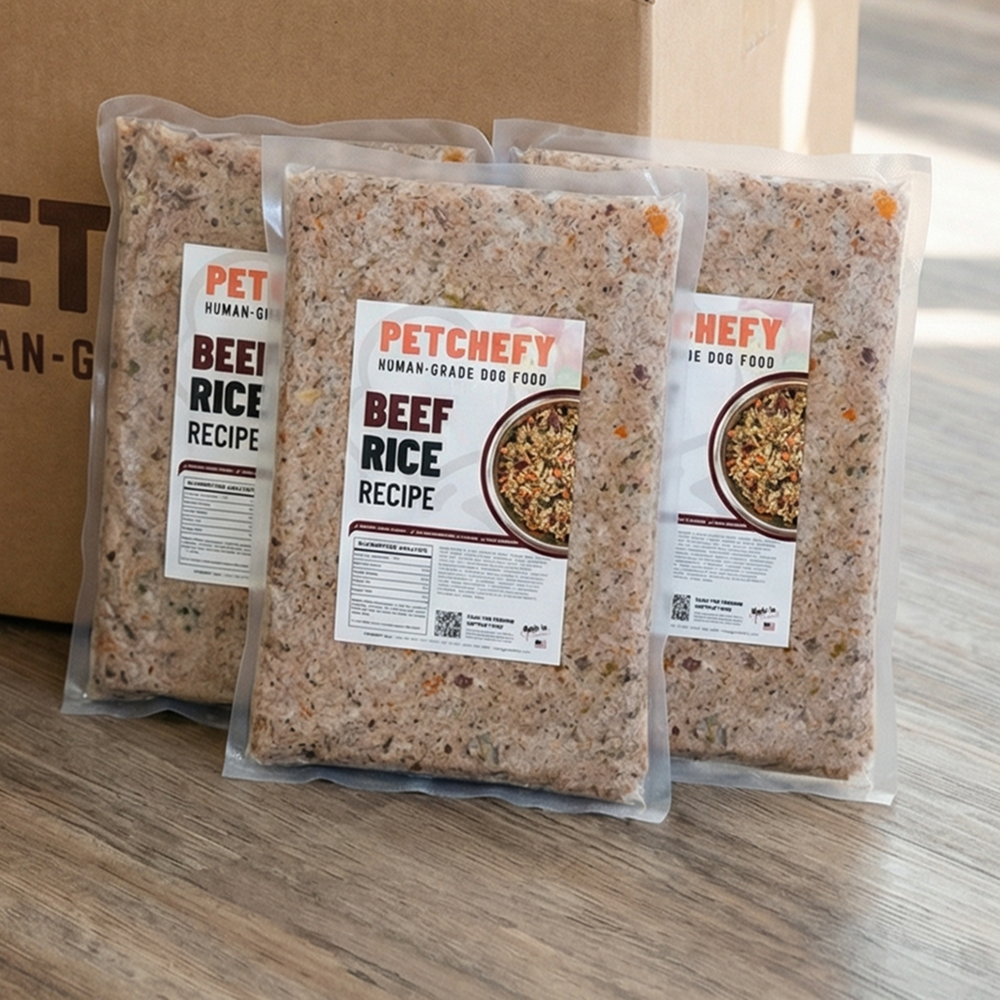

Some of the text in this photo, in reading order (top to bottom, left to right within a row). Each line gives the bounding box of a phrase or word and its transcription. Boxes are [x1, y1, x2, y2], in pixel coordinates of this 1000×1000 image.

[379, 320, 556, 367] PETCHEFY
[689, 312, 783, 351] HEFY
[512, 371, 547, 386] FOOD
[708, 350, 733, 365] DOG
[740, 354, 775, 369] FOOD
[190, 376, 263, 419] RICE
[363, 390, 454, 434] BEEF
[187, 420, 260, 452] RECIPE
[361, 434, 443, 478] RICE
[359, 479, 436, 511] RECIPE
